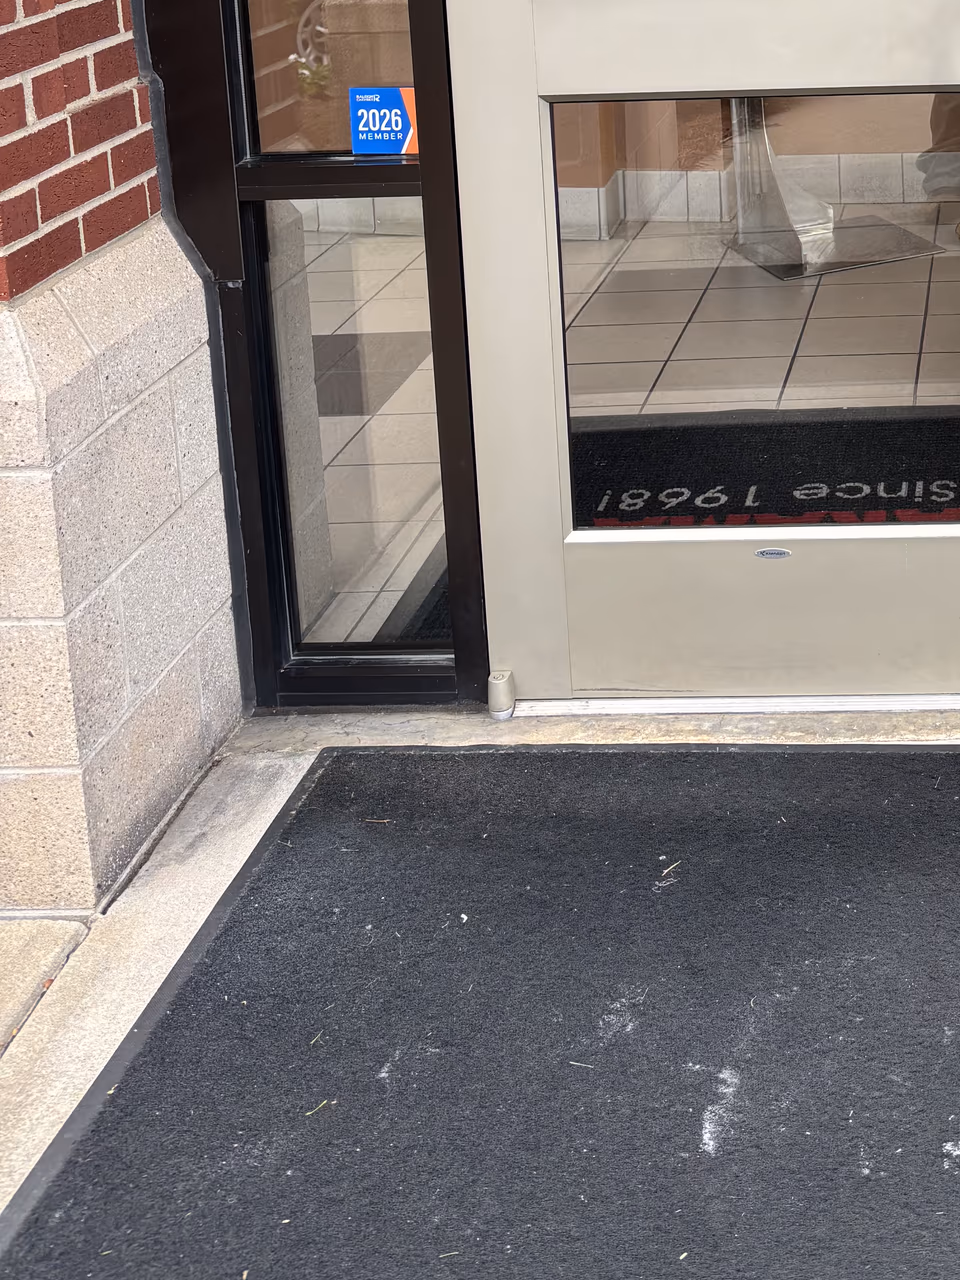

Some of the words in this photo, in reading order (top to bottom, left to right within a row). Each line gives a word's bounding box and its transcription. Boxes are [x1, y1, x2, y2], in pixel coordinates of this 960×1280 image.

[357, 108, 403, 131] 2026
[359, 132, 403, 140] MEMBER
[597, 484, 761, 512] 1968!
[793, 480, 958, 503] Since
